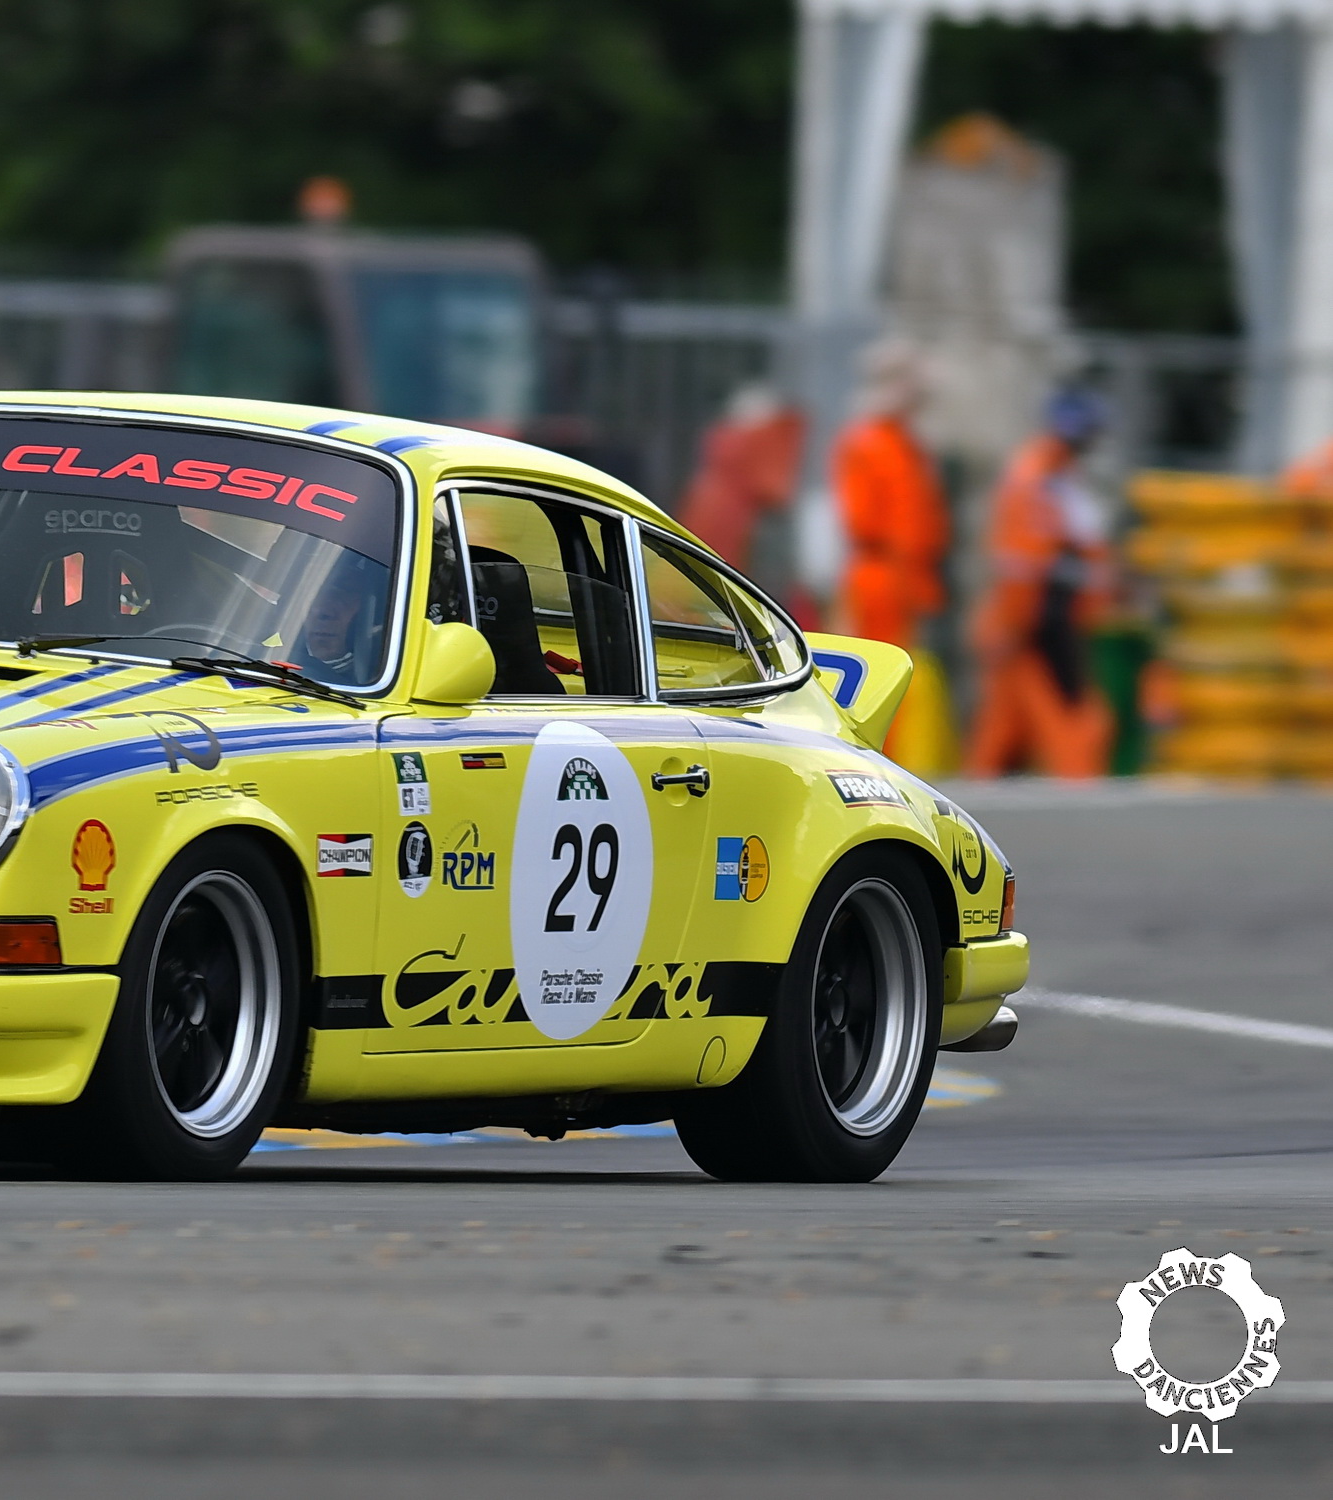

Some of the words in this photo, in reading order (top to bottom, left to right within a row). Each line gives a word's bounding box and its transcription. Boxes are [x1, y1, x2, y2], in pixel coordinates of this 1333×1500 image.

[2, 446, 358, 521] CLASSIC
[155, 783, 260, 806] PORSCHE
[319, 849, 371, 863] CHAMPION
[442, 852, 495, 890] RPM
[543, 823, 619, 932] 29
[69, 898, 114, 914] Shell
[574, 968, 603, 985] Classic
